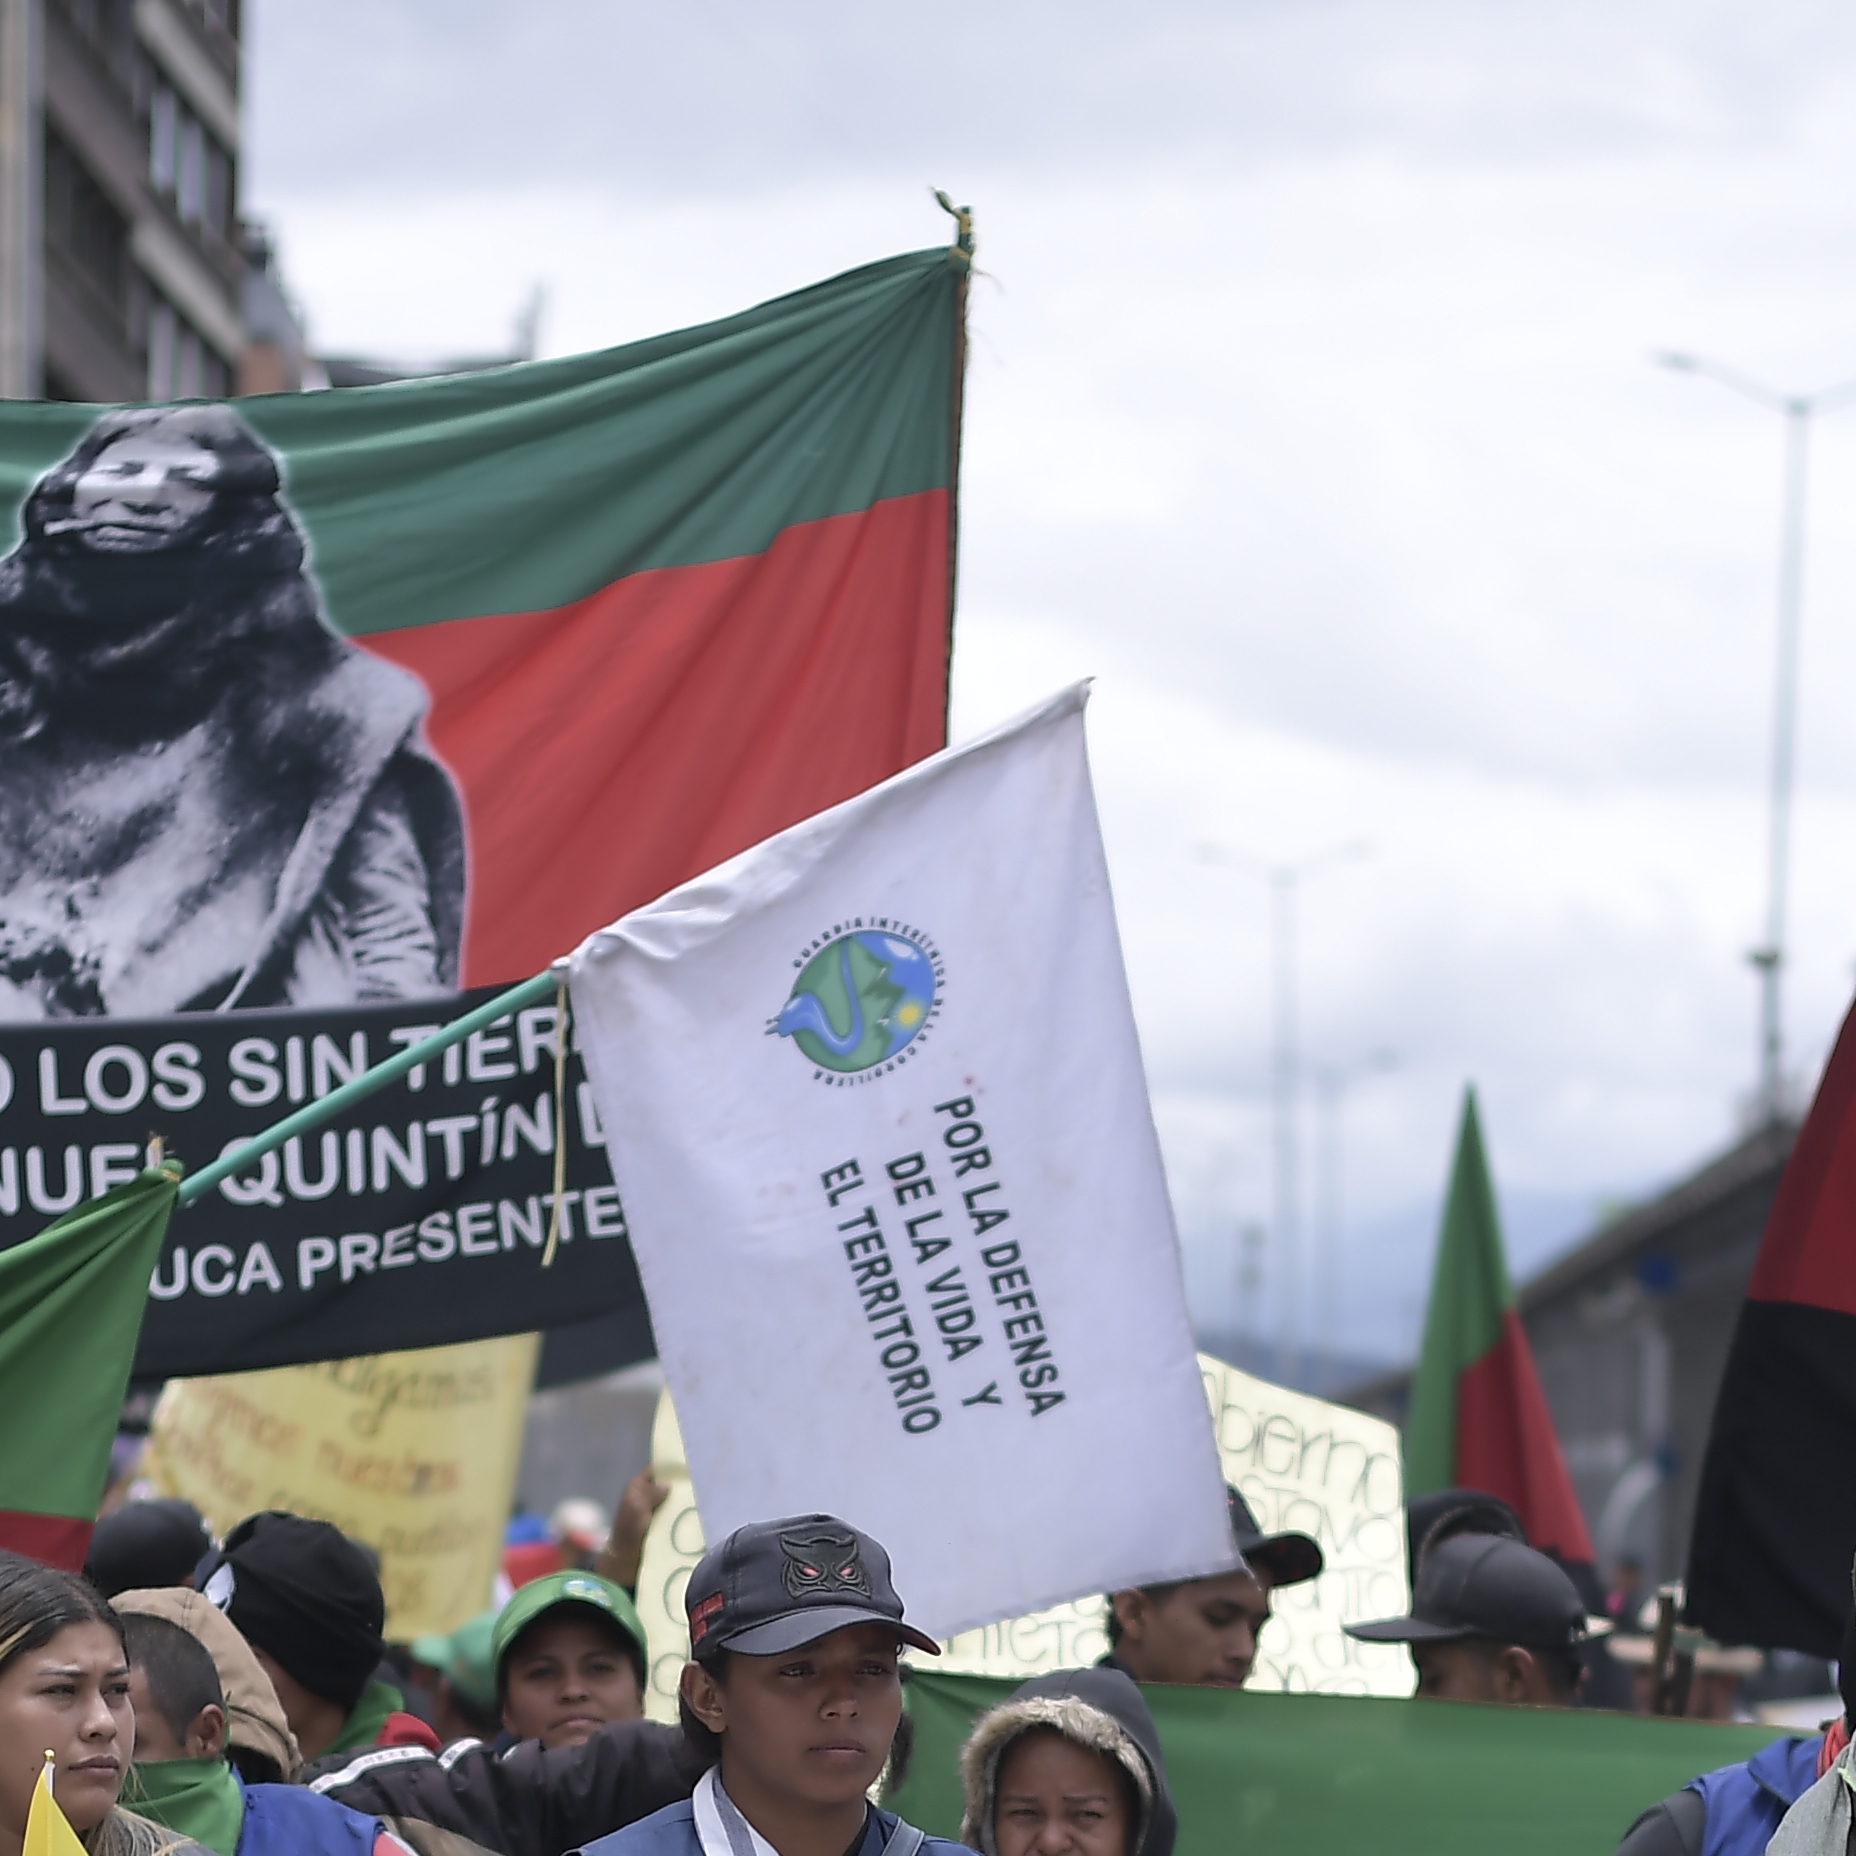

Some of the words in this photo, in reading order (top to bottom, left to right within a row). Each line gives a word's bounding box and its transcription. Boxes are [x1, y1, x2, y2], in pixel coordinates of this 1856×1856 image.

[37, 1041, 207, 1115] LOS
[227, 1030, 369, 1108] SIN
[388, 1005, 582, 1093] TIER
[217, 1092, 556, 1209] QUINTÍN
[886, 1152, 935, 1207] DE
[934, 1095, 992, 1178] POR
[820, 1158, 865, 1210] EL
[964, 1180, 1011, 1236] LA
[148, 1239, 285, 1300] UCA
[296, 1186, 626, 1291] PRESENTE
[905, 1208, 954, 1264] LA
[836, 1207, 943, 1436] TERRITORIO
[924, 1265, 982, 1362] VIDA
[981, 1240, 1067, 1418] DEFENSA
[961, 1380, 1004, 1409] Y
